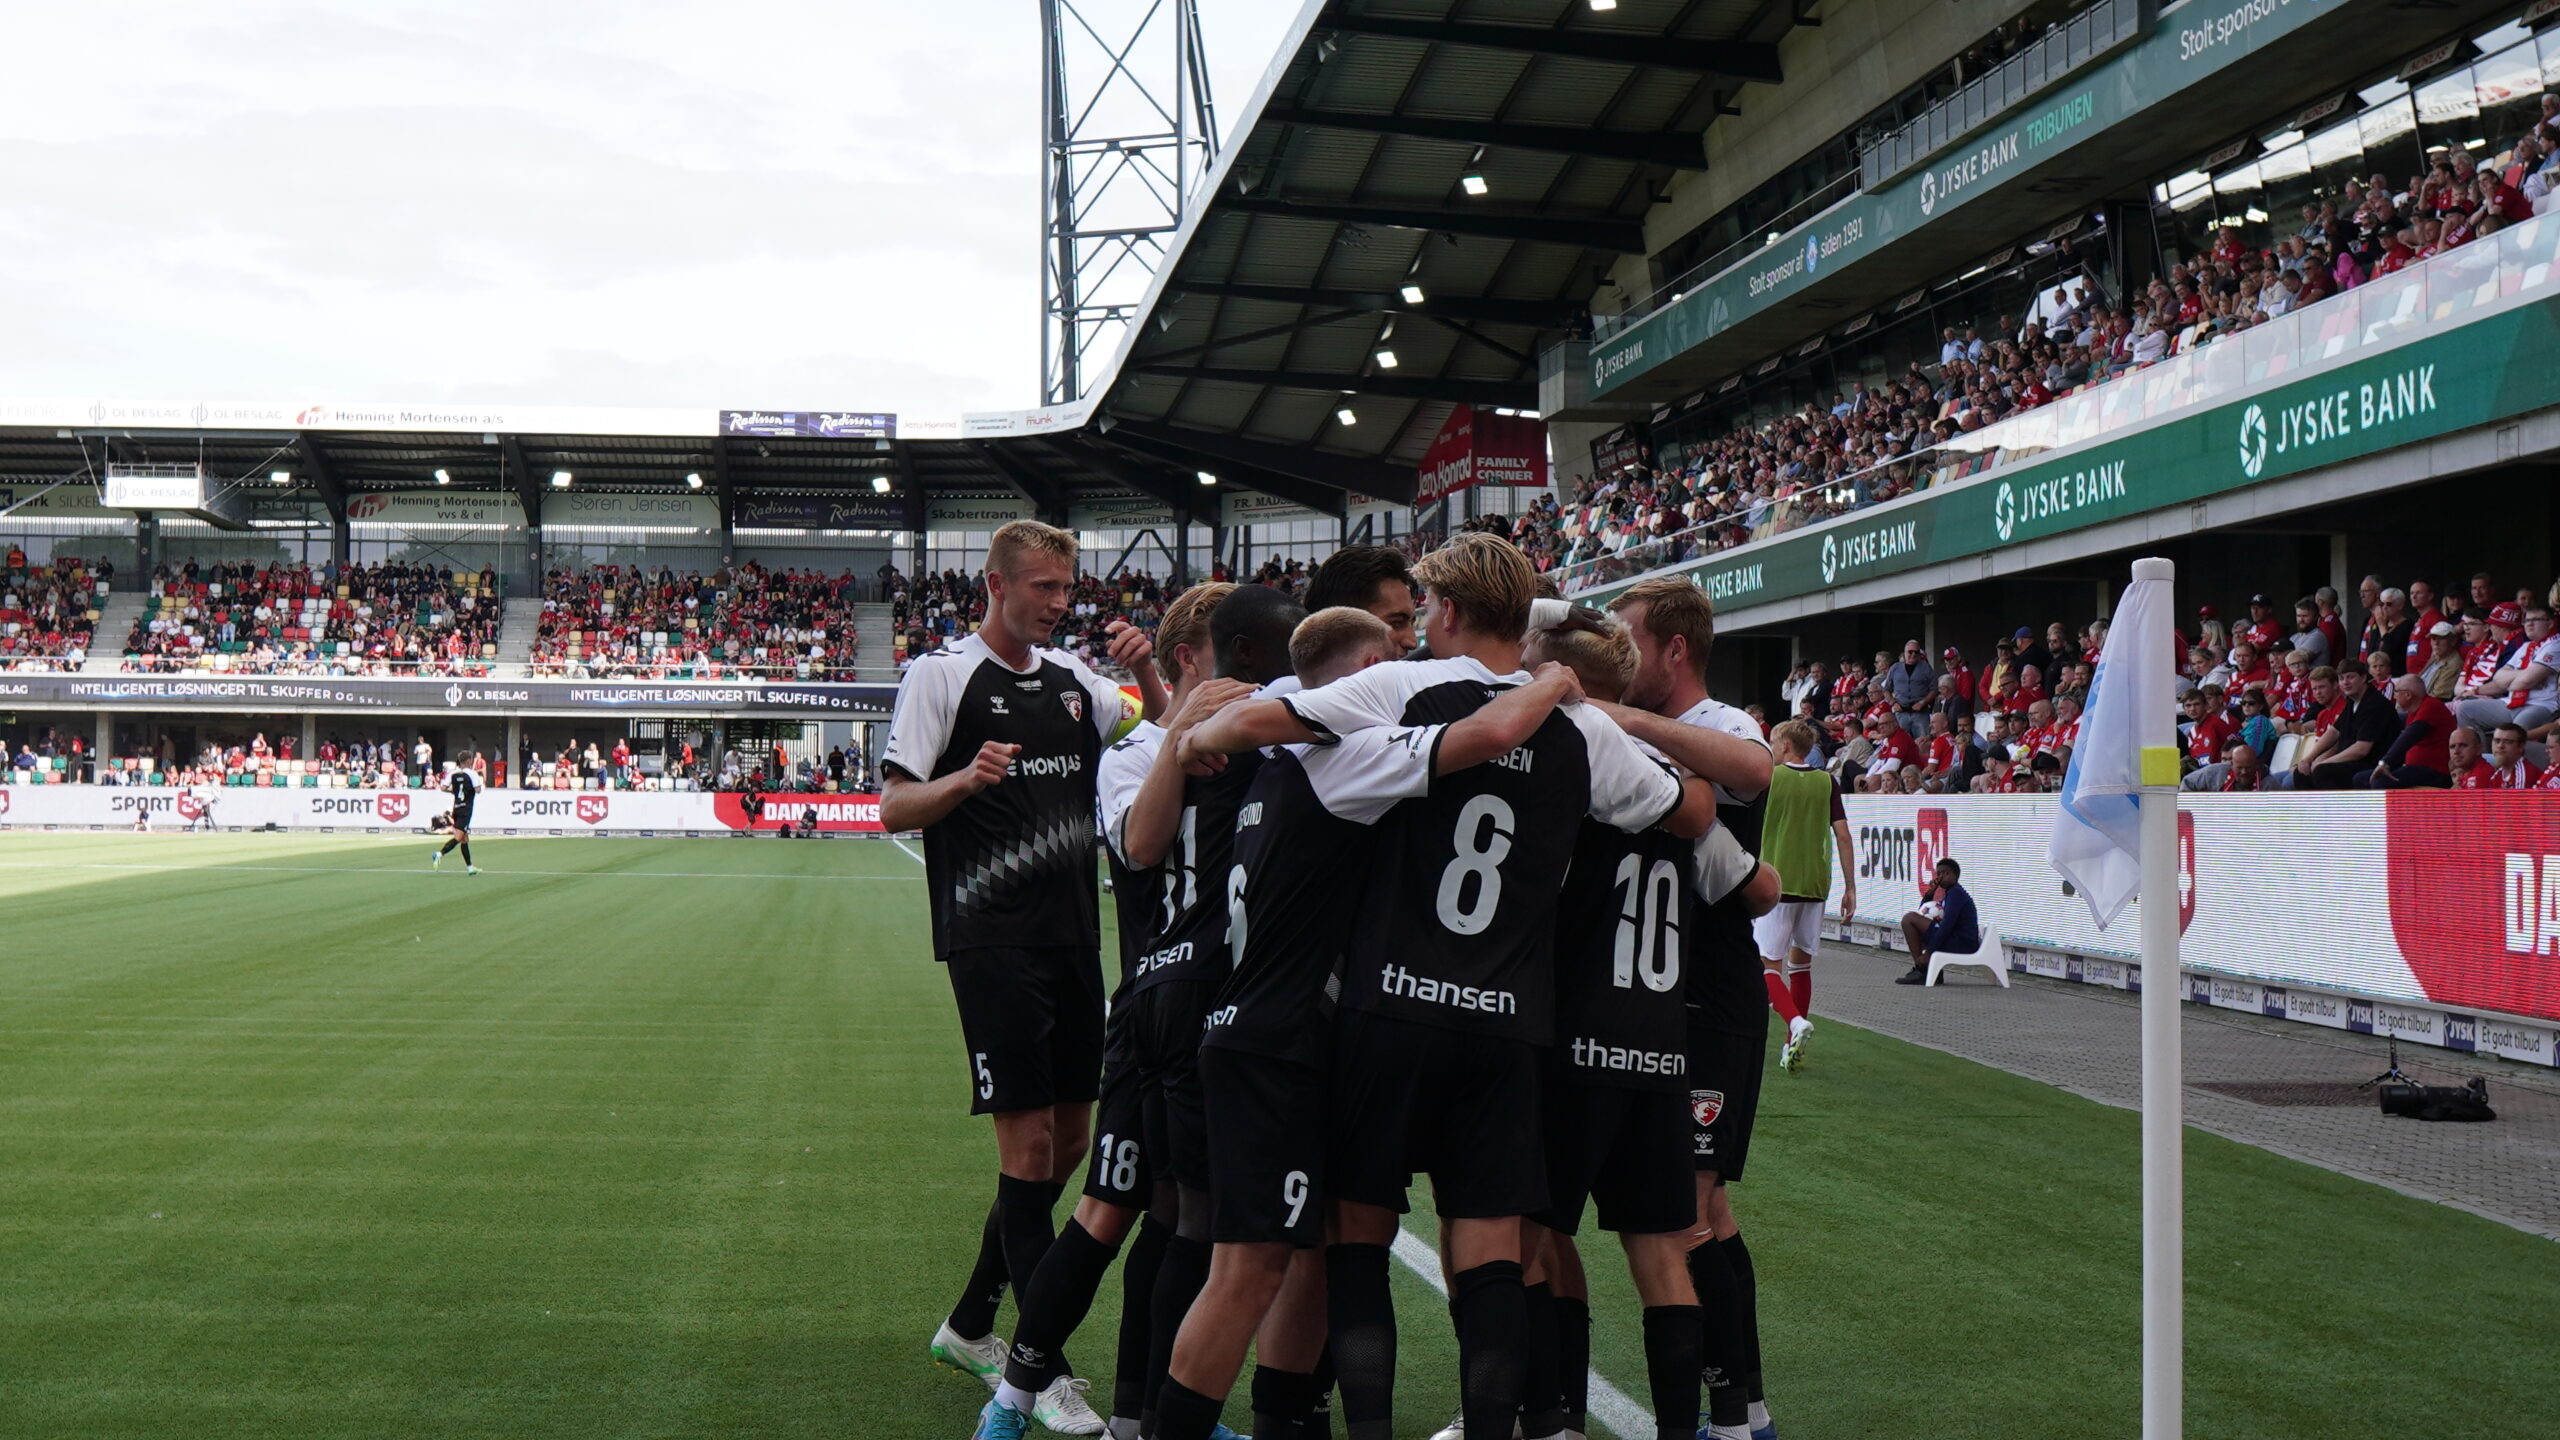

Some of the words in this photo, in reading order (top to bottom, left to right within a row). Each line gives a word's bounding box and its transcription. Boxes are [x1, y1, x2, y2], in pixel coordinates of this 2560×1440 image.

[2180, 19, 2214, 61] Stolt
[1939, 155, 1978, 199] JYSKE
[1981, 132, 2019, 176] BANK
[2026, 91, 2093, 150] TRIBUNEN
[1820, 234, 1842, 260] siden
[1842, 216, 1863, 248] 1991
[1749, 272, 1766, 298] Stolt
[1766, 258, 1795, 292] sponsor
[1795, 247, 1804, 273] af
[1604, 351, 1625, 378] JYSKE
[1625, 340, 1643, 368] BANK
[336, 411, 395, 425] Henning
[400, 411, 478, 423] Mortensen
[483, 412, 504, 424] a/s
[2276, 391, 2351, 454] JYSKE
[2360, 363, 2437, 430] BANK
[729, 411, 783, 431] Radisson
[819, 413, 873, 433] Radisson
[1476, 456, 1530, 468] FAMILY
[1476, 469, 1534, 481] CORNER
[392, 495, 442, 510] Henning
[444, 495, 508, 508] Mortensen
[570, 494, 622, 511] Søren
[629, 494, 692, 512] Jensen
[2020, 476, 2070, 523] JYSKE
[2074, 460, 2127, 510] BANK
[437, 509, 458, 520] vvs
[460, 509, 469, 520] &
[471, 508, 484, 520] el
[744, 500, 803, 521] Radisson
[830, 501, 888, 523] Radisson
[931, 508, 1018, 522] Skabertrang
[1234, 498, 1251, 509] FR.
[1840, 532, 1876, 569] JYSKE
[1881, 520, 1916, 559] BANK
[1736, 563, 1763, 593] BANK
[2501, 610, 2521, 622] SIF
[70, 683, 165, 697] INTELLIGENTE
[167, 682, 245, 697] LØSNINGER
[248, 683, 268, 697] TIL
[270, 685, 331, 700] SKUFFER
[335, 692, 354, 702] OG
[466, 690, 481, 700] OL
[484, 690, 529, 702] BESLAG
[570, 689, 663, 702] INTELLIGENTE
[665, 688, 743, 703] LØSNINGER
[745, 690, 766, 703] TIL
[767, 691, 827, 706] SKUFFER
[830, 698, 849, 708] OG
[1488, 746, 1534, 774] SEN
[111, 796, 174, 811] SPORT
[457, 784, 464, 801] 4
[312, 798, 374, 814] SPORT
[380, 798, 411, 816] 24
[511, 800, 573, 816] SPORT
[580, 799, 607, 817] 24
[1435, 793, 1515, 936] 8
[1860, 826, 1914, 882] SPORT
[1612, 852, 1680, 993] 10
[2092, 964, 2105, 980] godt
[2105, 966, 2120, 980] tilbud
[1381, 962, 1516, 1015] thansen
[2193, 979, 2210, 996] JYSK
[2214, 982, 2221, 998] Et
[2221, 985, 2235, 1003] godt
[2235, 986, 2254, 1004] tilbud
[2266, 992, 2286, 1010] JYSK
[2290, 996, 2298, 1011] Et
[2298, 999, 2315, 1017] godt
[2315, 1001, 2337, 1018] tilbud
[2351, 1005, 2373, 1025] JYSK
[2378, 1009, 2387, 1026] Et
[2388, 1012, 2406, 1032] godt
[2407, 1013, 2432, 1034] tilbud
[2449, 1021, 2475, 1042] JYSK
[2482, 1026, 2491, 1043] Et
[2492, 1029, 2513, 1050] godt
[2514, 1031, 2541, 1053] tilbud
[1572, 1036, 1686, 1076] thansen
[975, 1052, 994, 1101] 5
[1098, 1132, 1140, 1192] 18
[1283, 1169, 1309, 1229] 9
[1011, 1351, 1046, 1369] hummel
